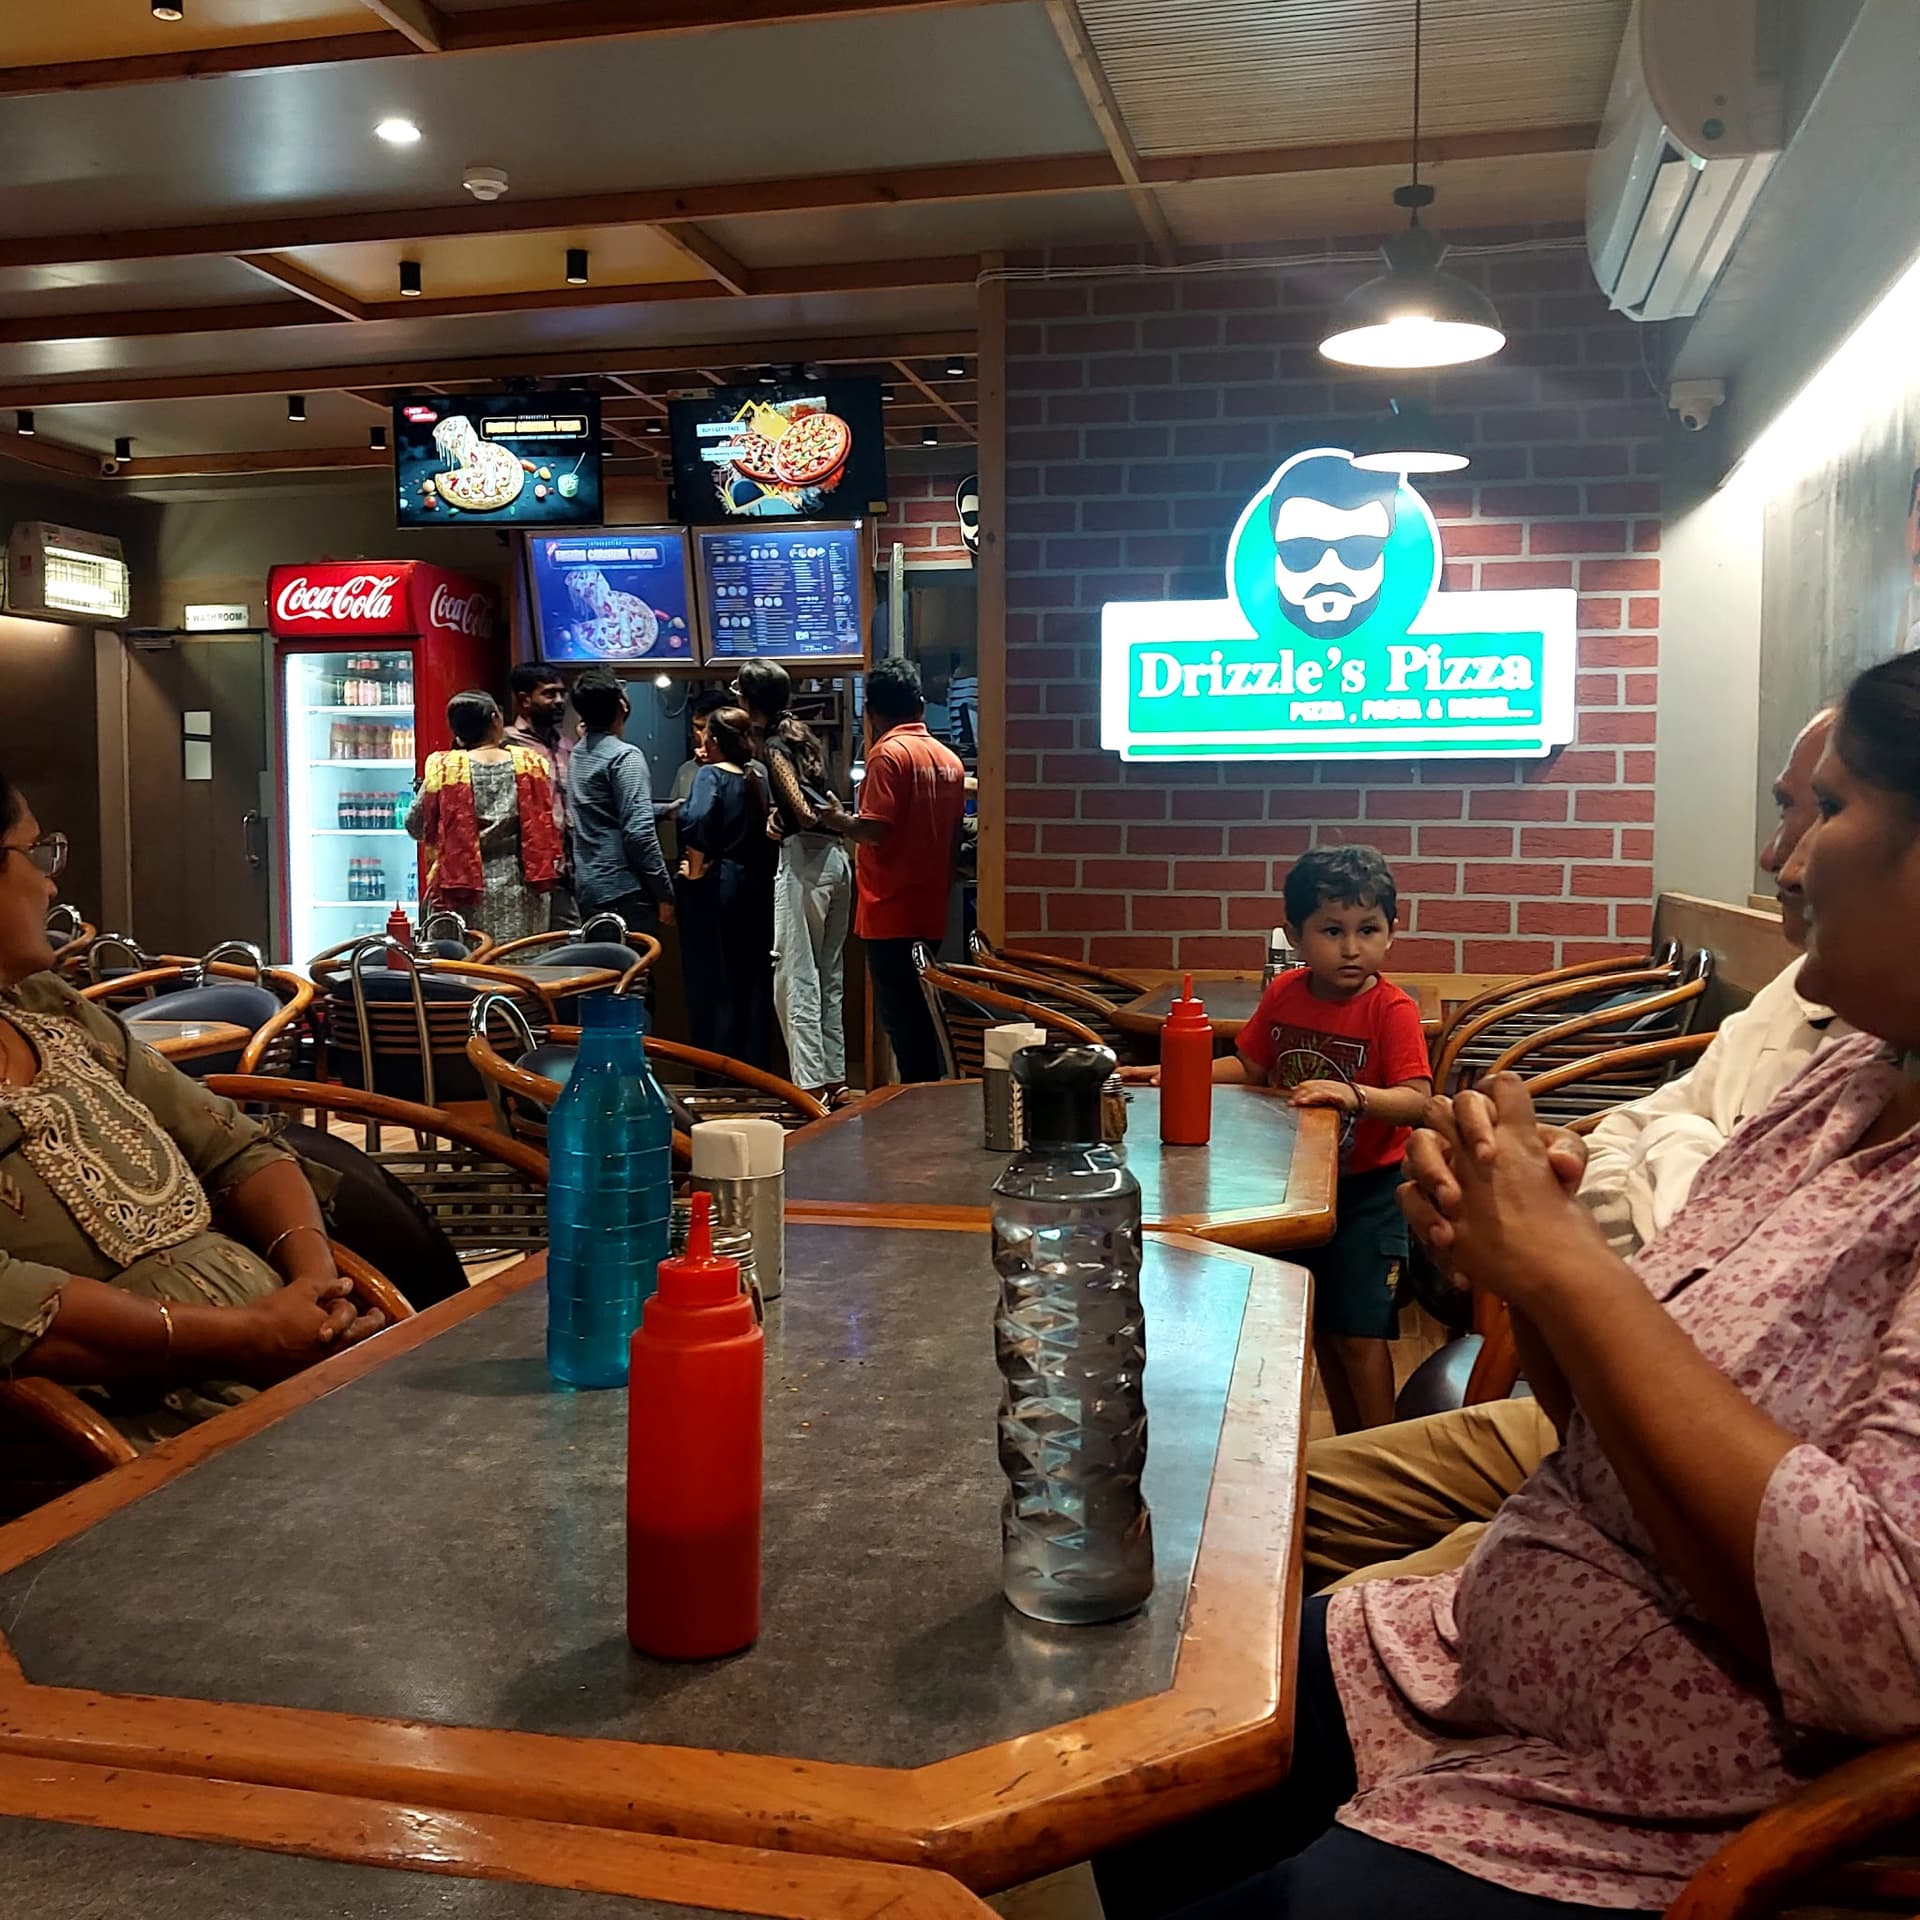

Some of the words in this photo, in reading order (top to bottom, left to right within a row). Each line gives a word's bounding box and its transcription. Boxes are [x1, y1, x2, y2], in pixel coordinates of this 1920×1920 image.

[276, 575, 400, 620] Coca-Cola
[1138, 646, 1367, 698] Drizzle's
[1385, 643, 1535, 693] Pizza
